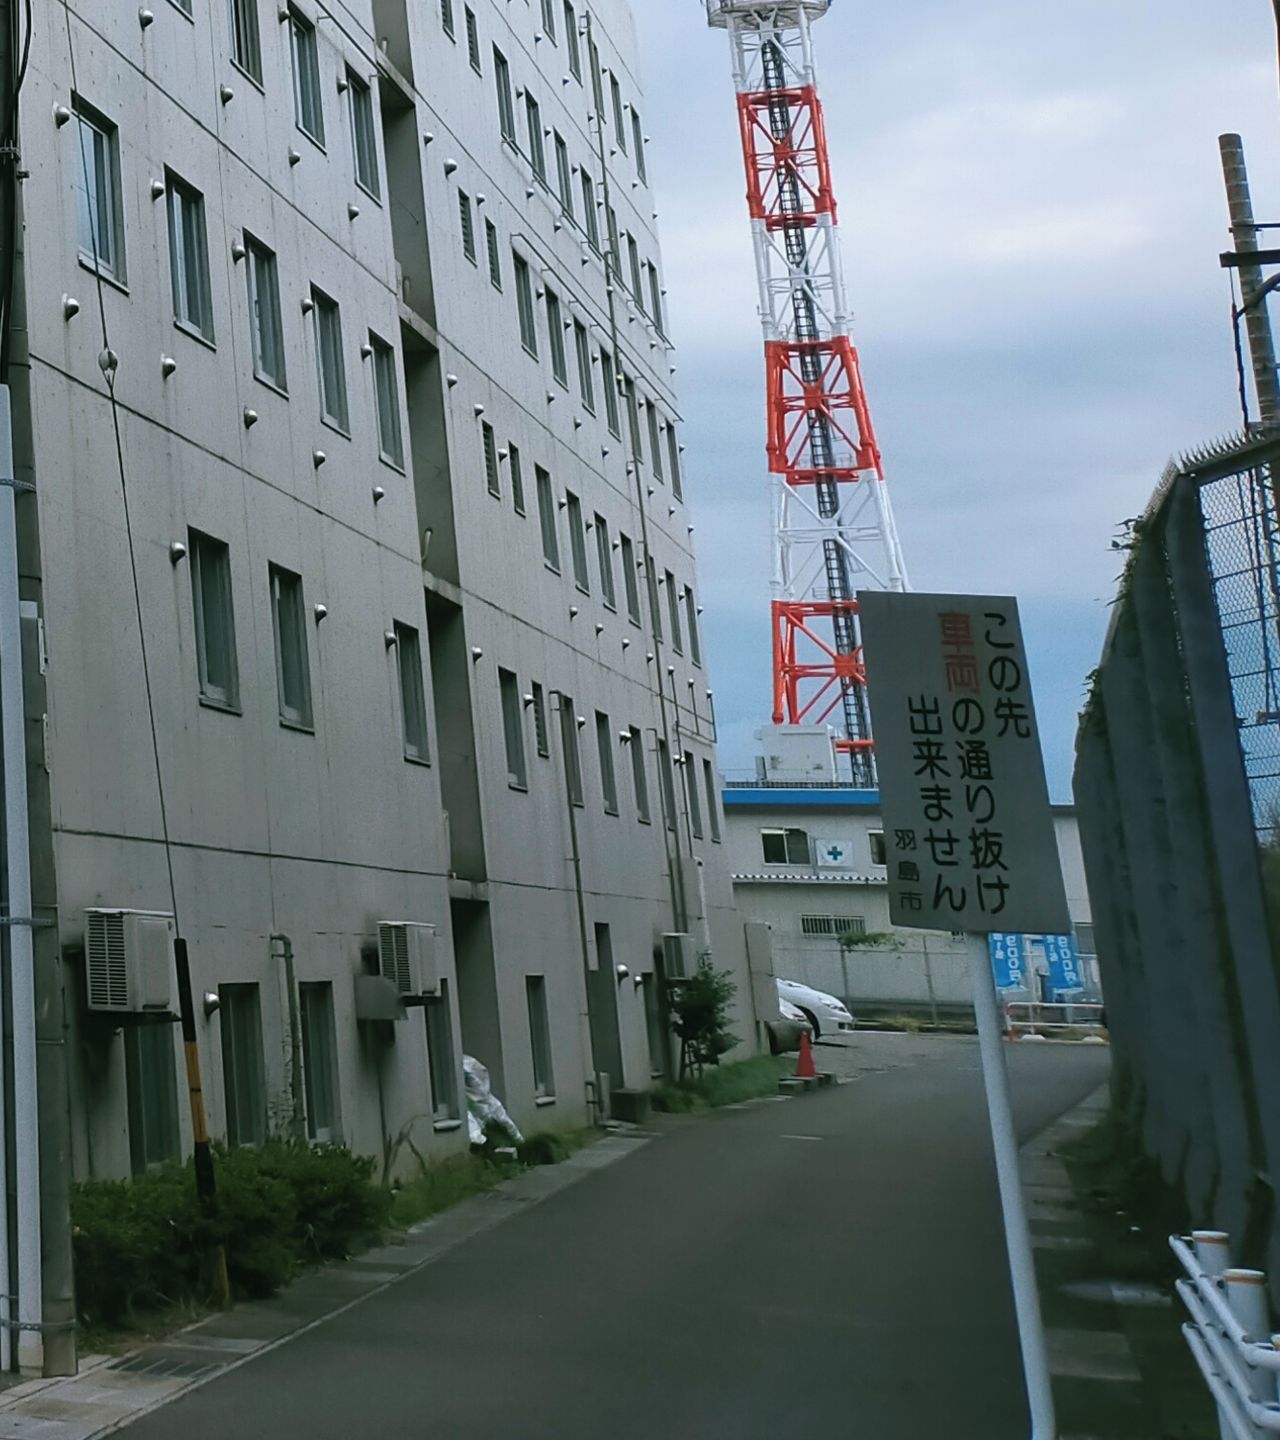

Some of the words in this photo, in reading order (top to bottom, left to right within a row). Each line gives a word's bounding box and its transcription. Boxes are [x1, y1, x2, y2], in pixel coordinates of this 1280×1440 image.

[937, 611, 1011, 915] 車両の通り抜け
[983, 612, 1031, 739] この先
[908, 694, 966, 912] 出来ません
